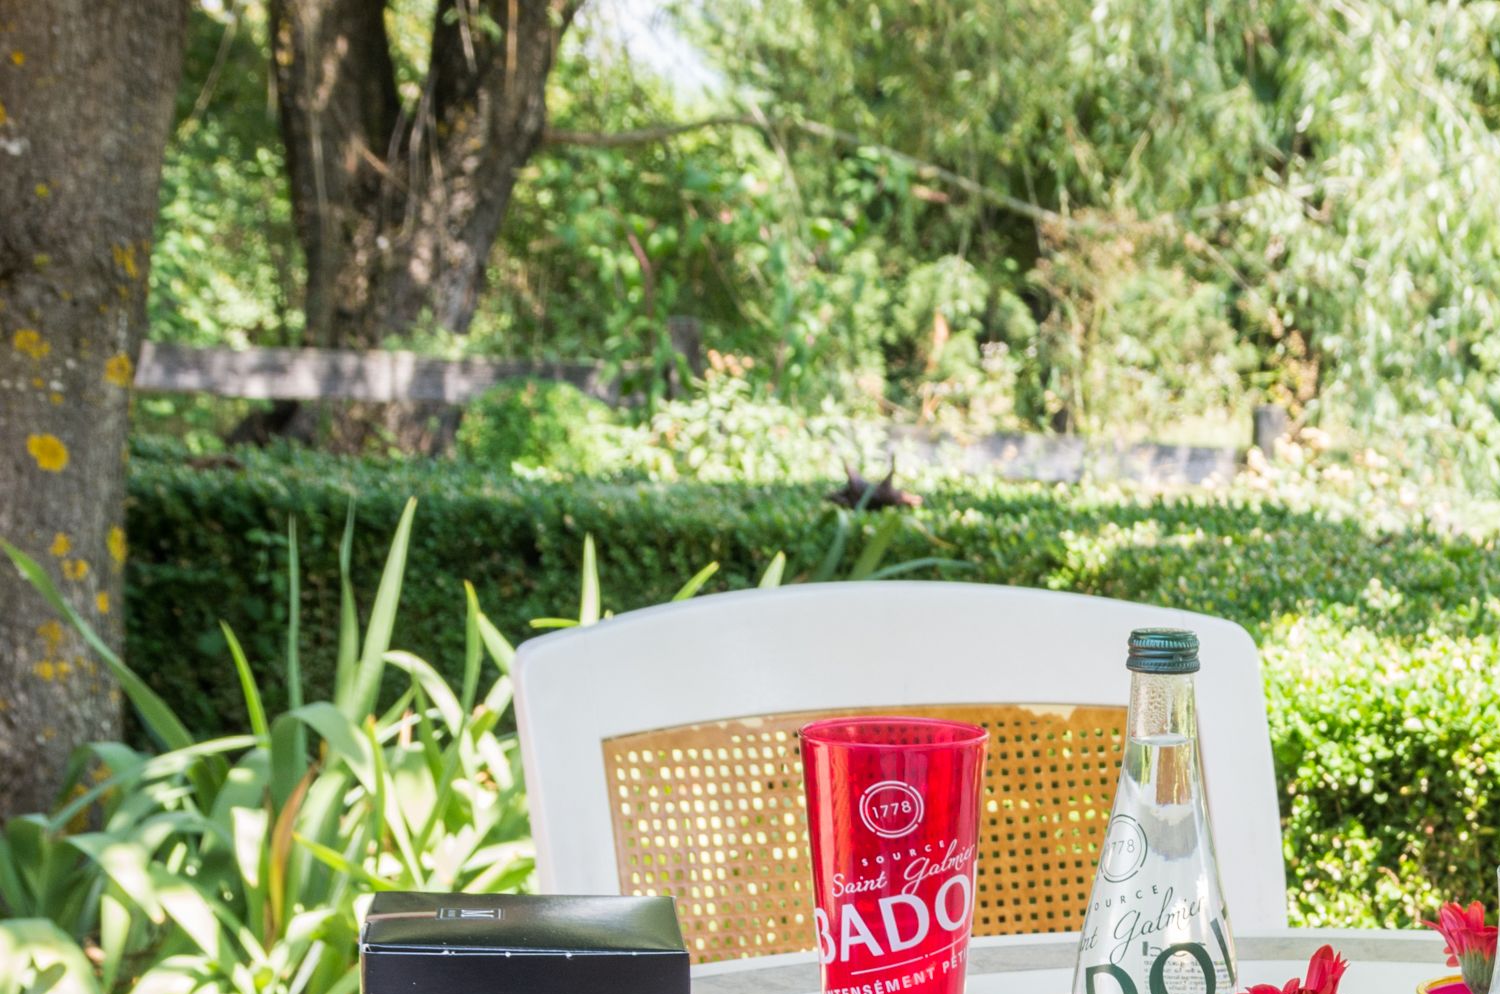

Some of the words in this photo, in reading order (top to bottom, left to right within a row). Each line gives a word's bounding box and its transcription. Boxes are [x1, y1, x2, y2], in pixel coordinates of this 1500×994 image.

[872, 800, 912, 819] 1778
[861, 840, 945, 867] SOURCE
[831, 871, 888, 898] Saint
[1088, 884, 1159, 913] OURCE
[814, 863, 977, 965] BADO
